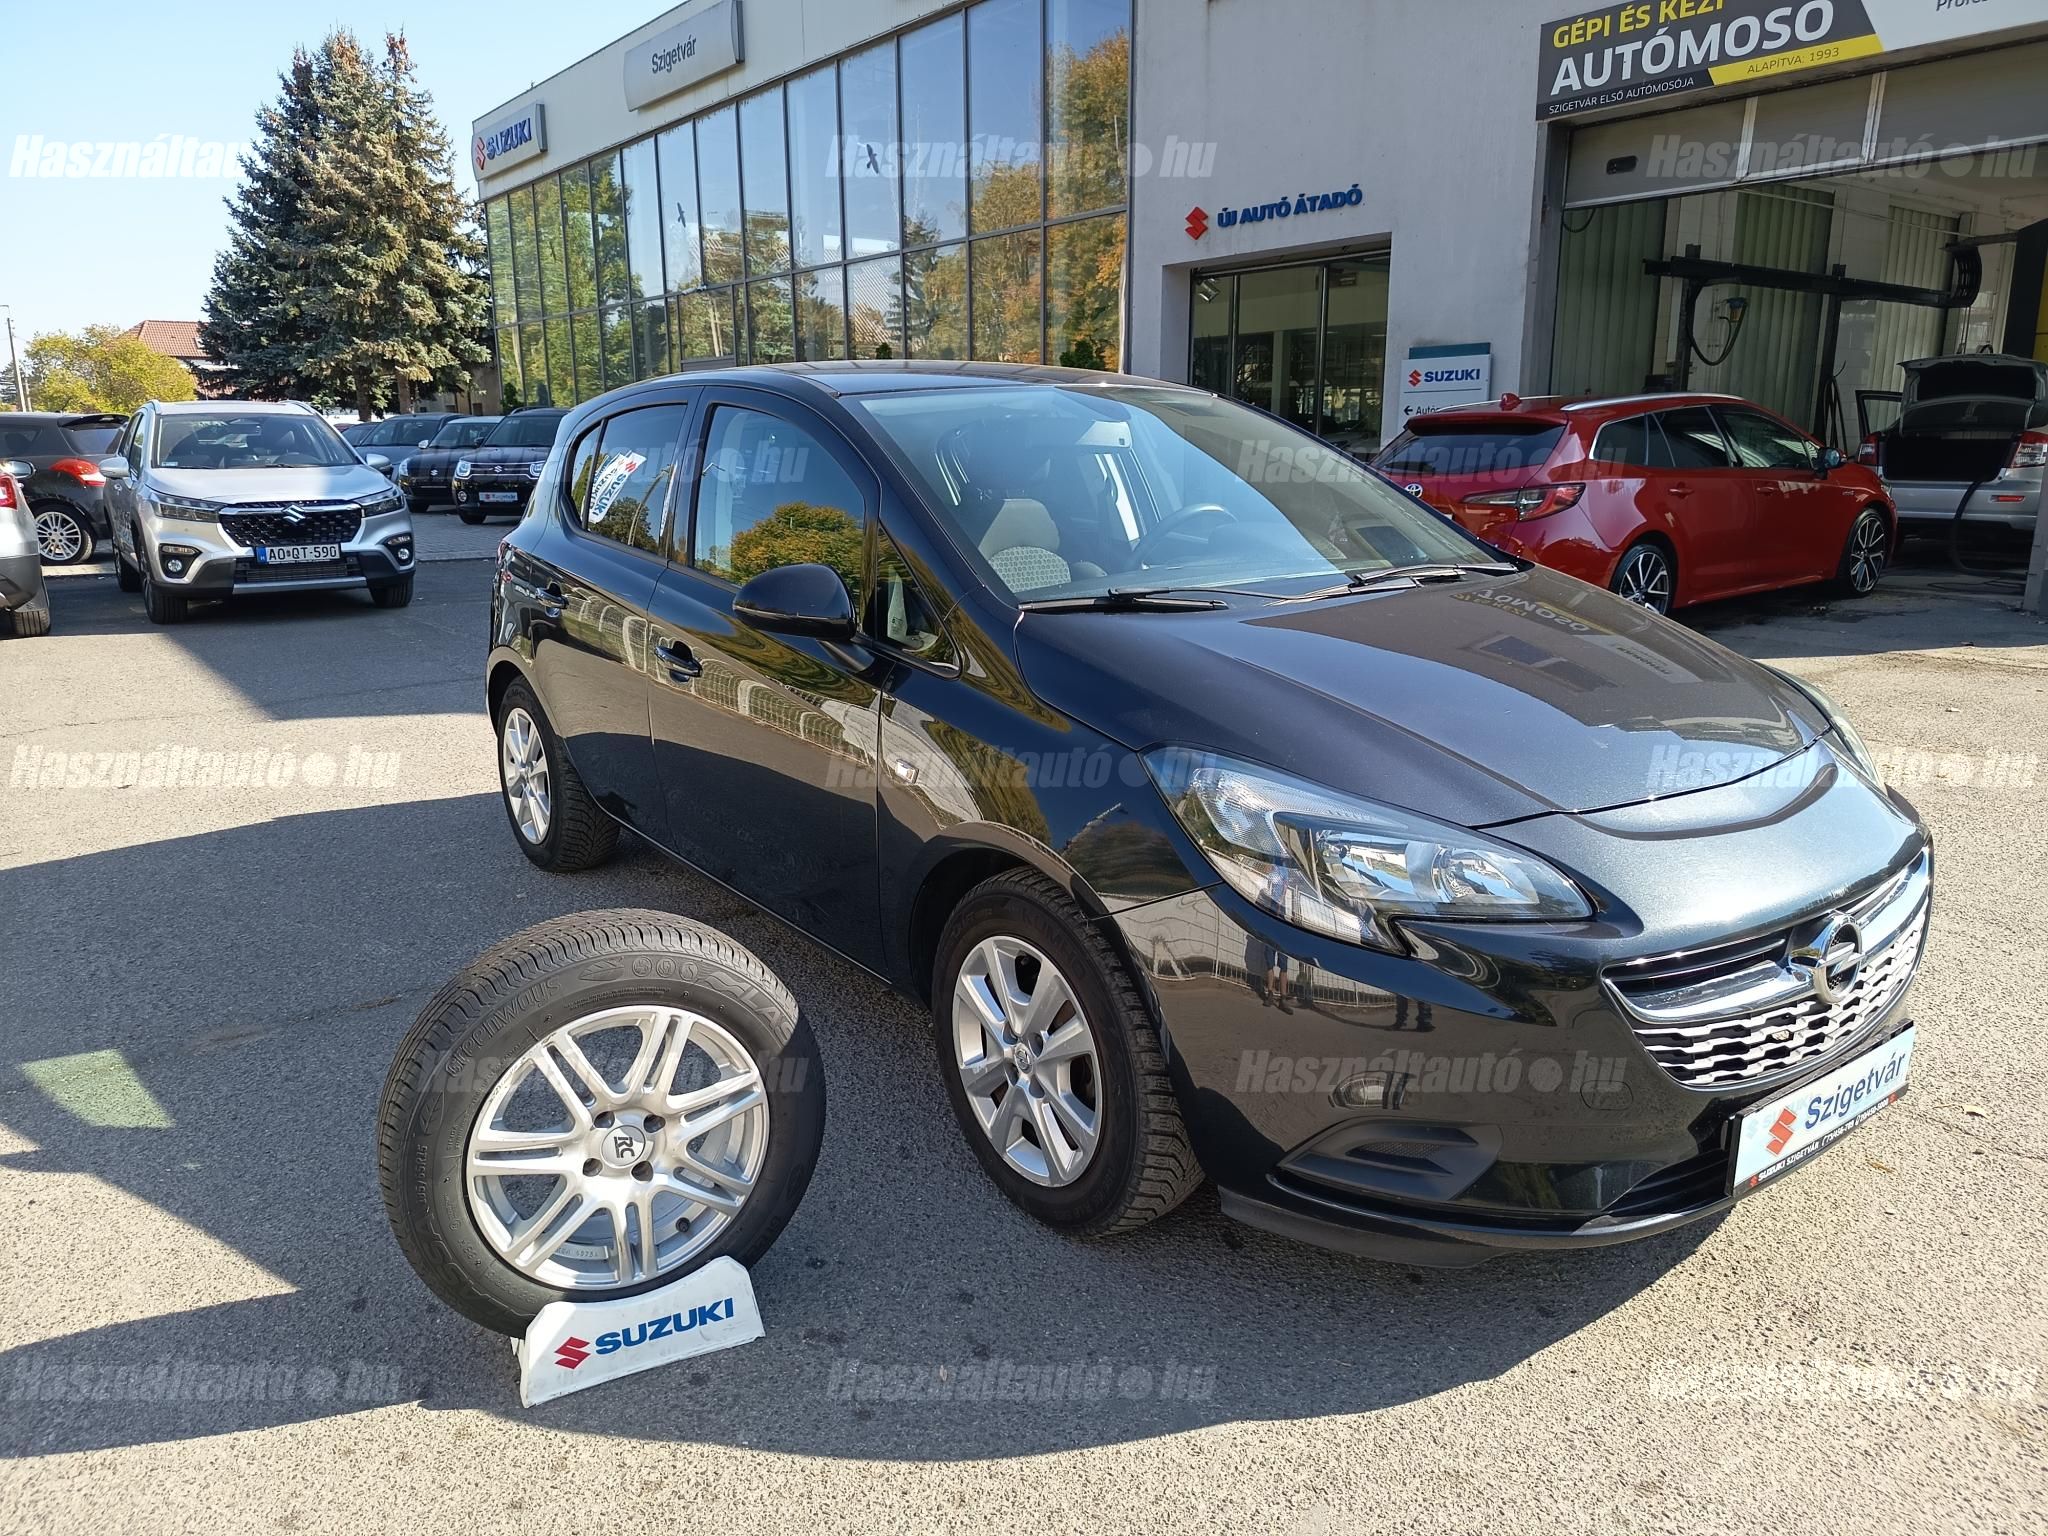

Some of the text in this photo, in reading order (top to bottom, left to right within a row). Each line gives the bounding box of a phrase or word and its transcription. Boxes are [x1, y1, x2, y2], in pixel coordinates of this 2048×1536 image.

[1553, 15, 1611, 48] GÉPI
[1619, 5, 1650, 33] ÉS
[651, 34, 697, 74] Szigetvár
[1809, 47, 1839, 62] 1993
[1549, 96, 1598, 114] SZIGETVÁR
[1625, 77, 1695, 99] AUTÓMOSÓJA
[486, 117, 532, 161] SUZUKI
[1217, 183, 1363, 227] ÚJ AUTÓ ÁTADÓ
[1424, 368, 1481, 383] SUZUKI
[592, 473, 627, 517] SUZUKI
[1804, 1051, 1906, 1131] Szigetvár
[1758, 1141, 1820, 1182] SUZUKI SZIGETVÁR
[594, 1297, 734, 1355] SUZUKI
